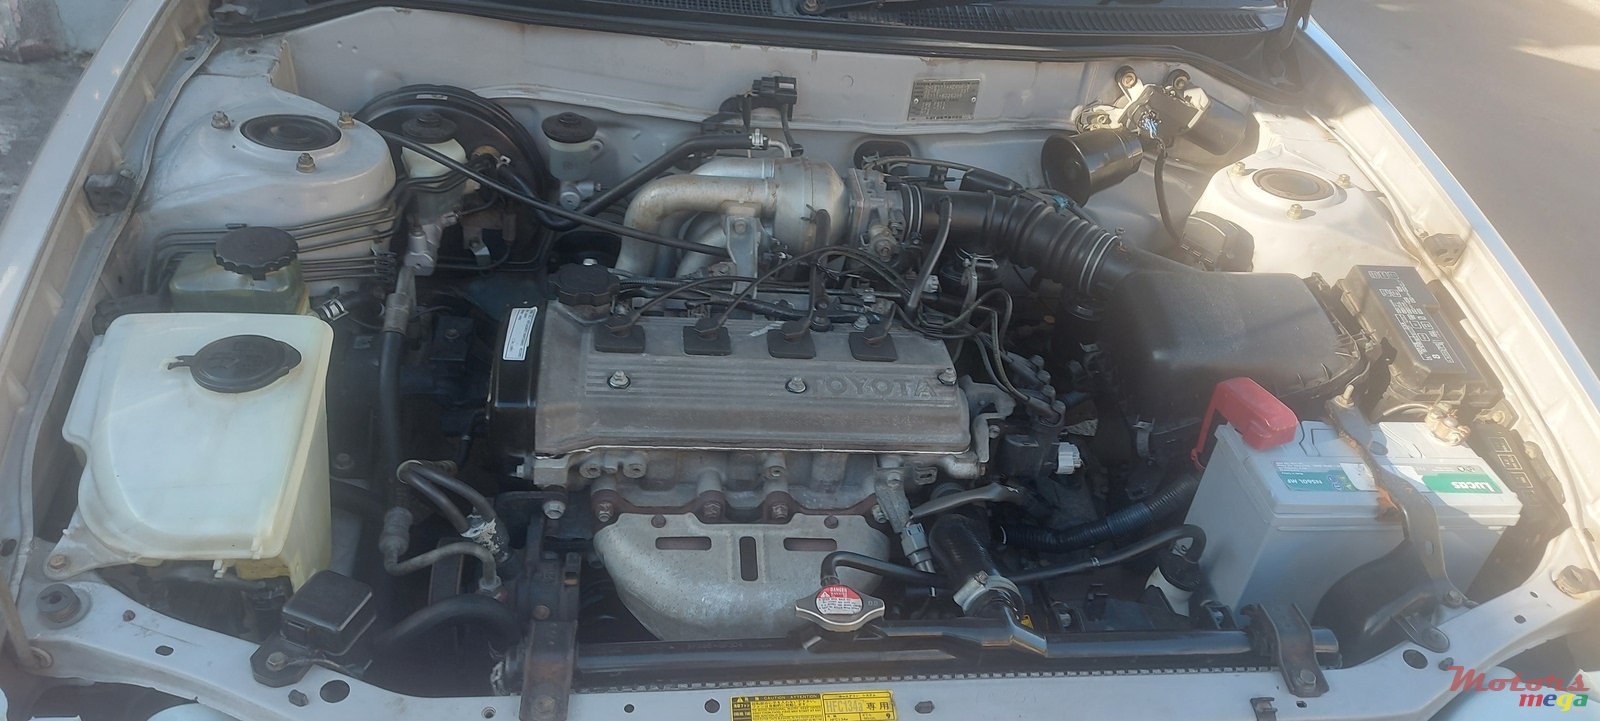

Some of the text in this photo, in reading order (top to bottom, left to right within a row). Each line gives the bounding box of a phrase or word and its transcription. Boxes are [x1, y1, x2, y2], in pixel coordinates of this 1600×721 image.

[811, 375, 938, 398] TOYOTA
[1450, 480, 1496, 493] Lucas
[825, 699, 864, 713] HFC134a
